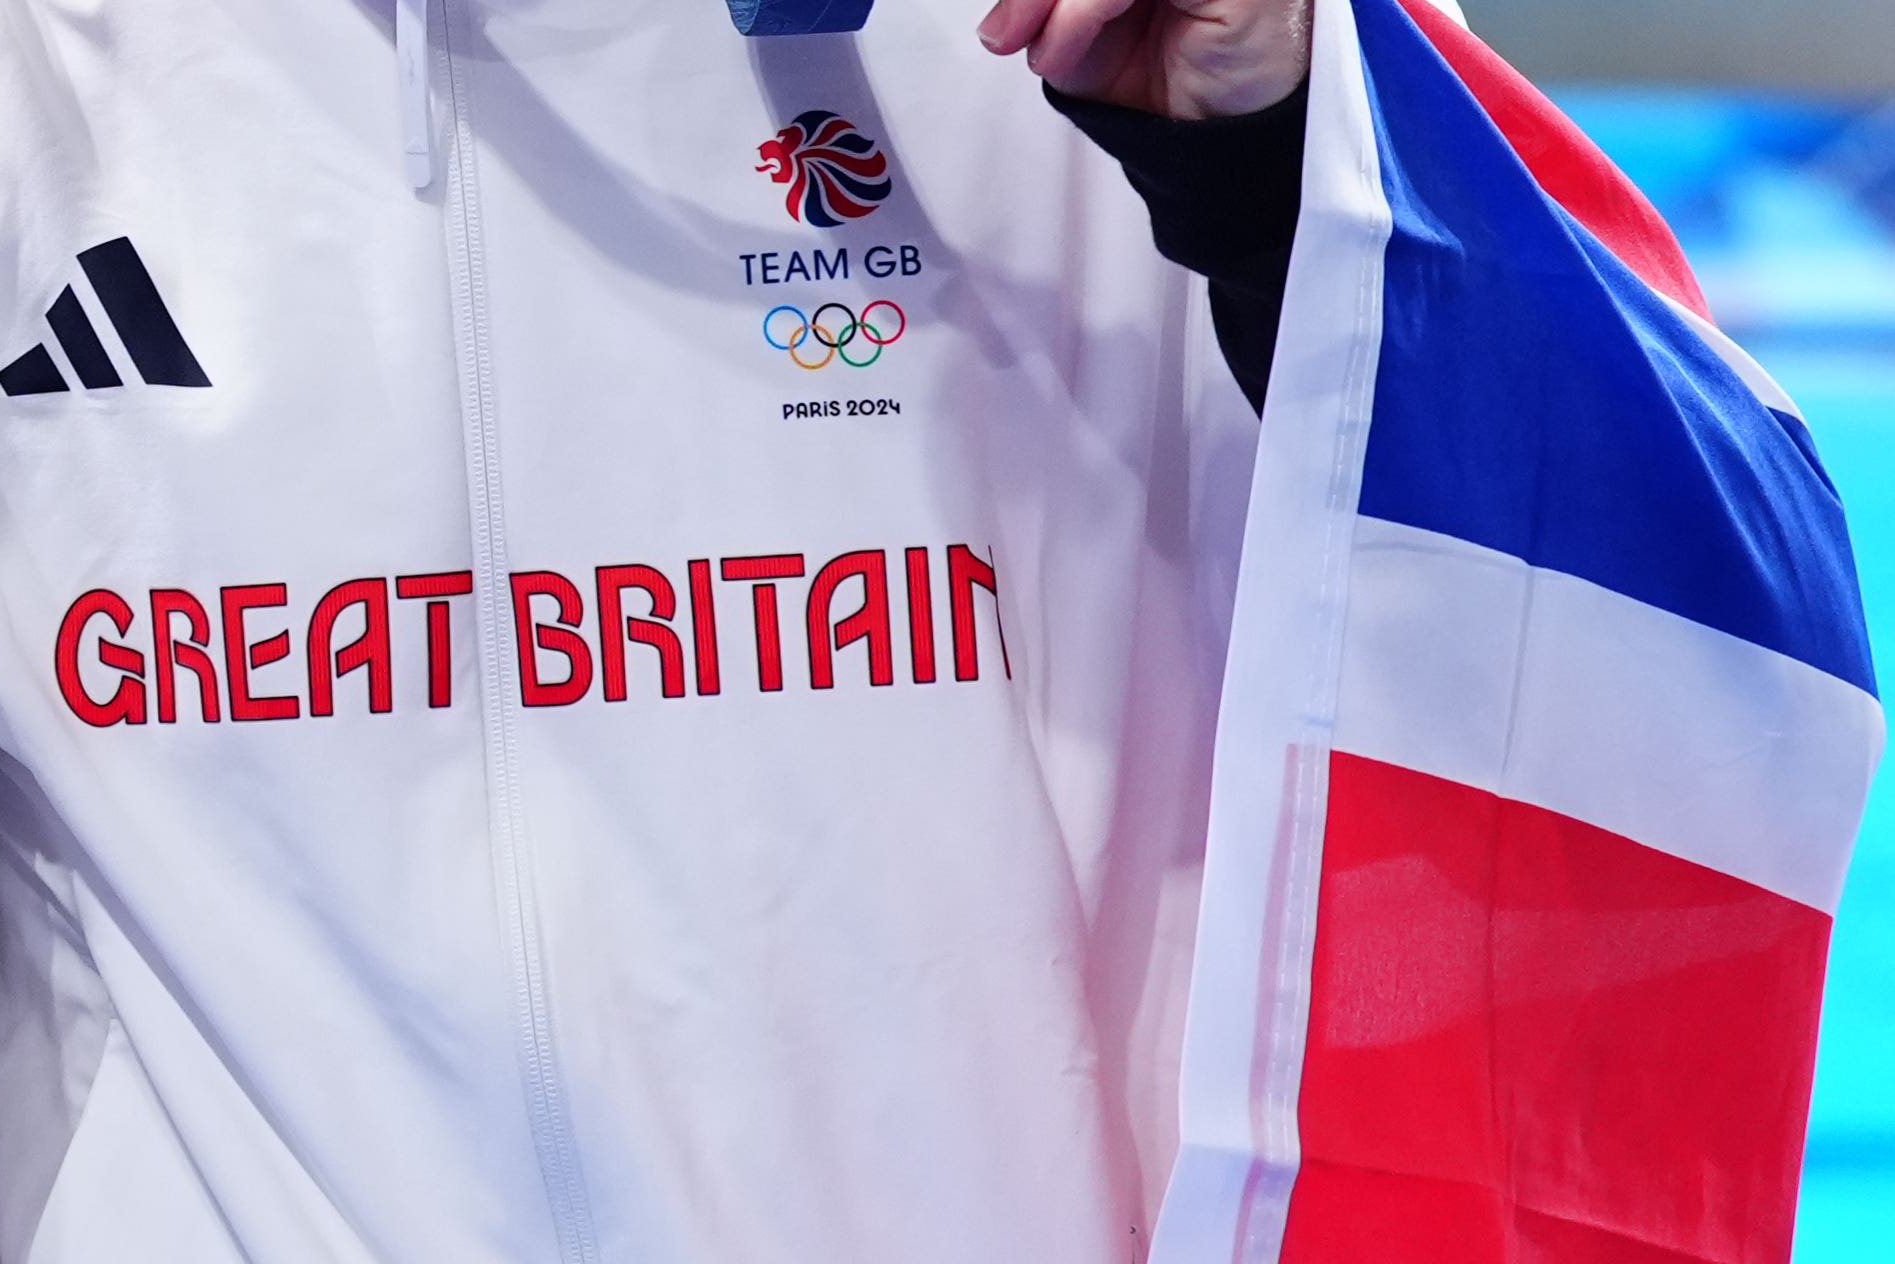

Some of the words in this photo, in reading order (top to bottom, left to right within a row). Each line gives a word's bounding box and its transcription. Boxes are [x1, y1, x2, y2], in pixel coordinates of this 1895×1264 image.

[739, 247, 849, 286] TEAM
[864, 244, 922, 278] GB
[846, 398, 901, 416] 2024
[54, 569, 473, 728] GREAT
[508, 543, 1012, 708] BRITAIN
